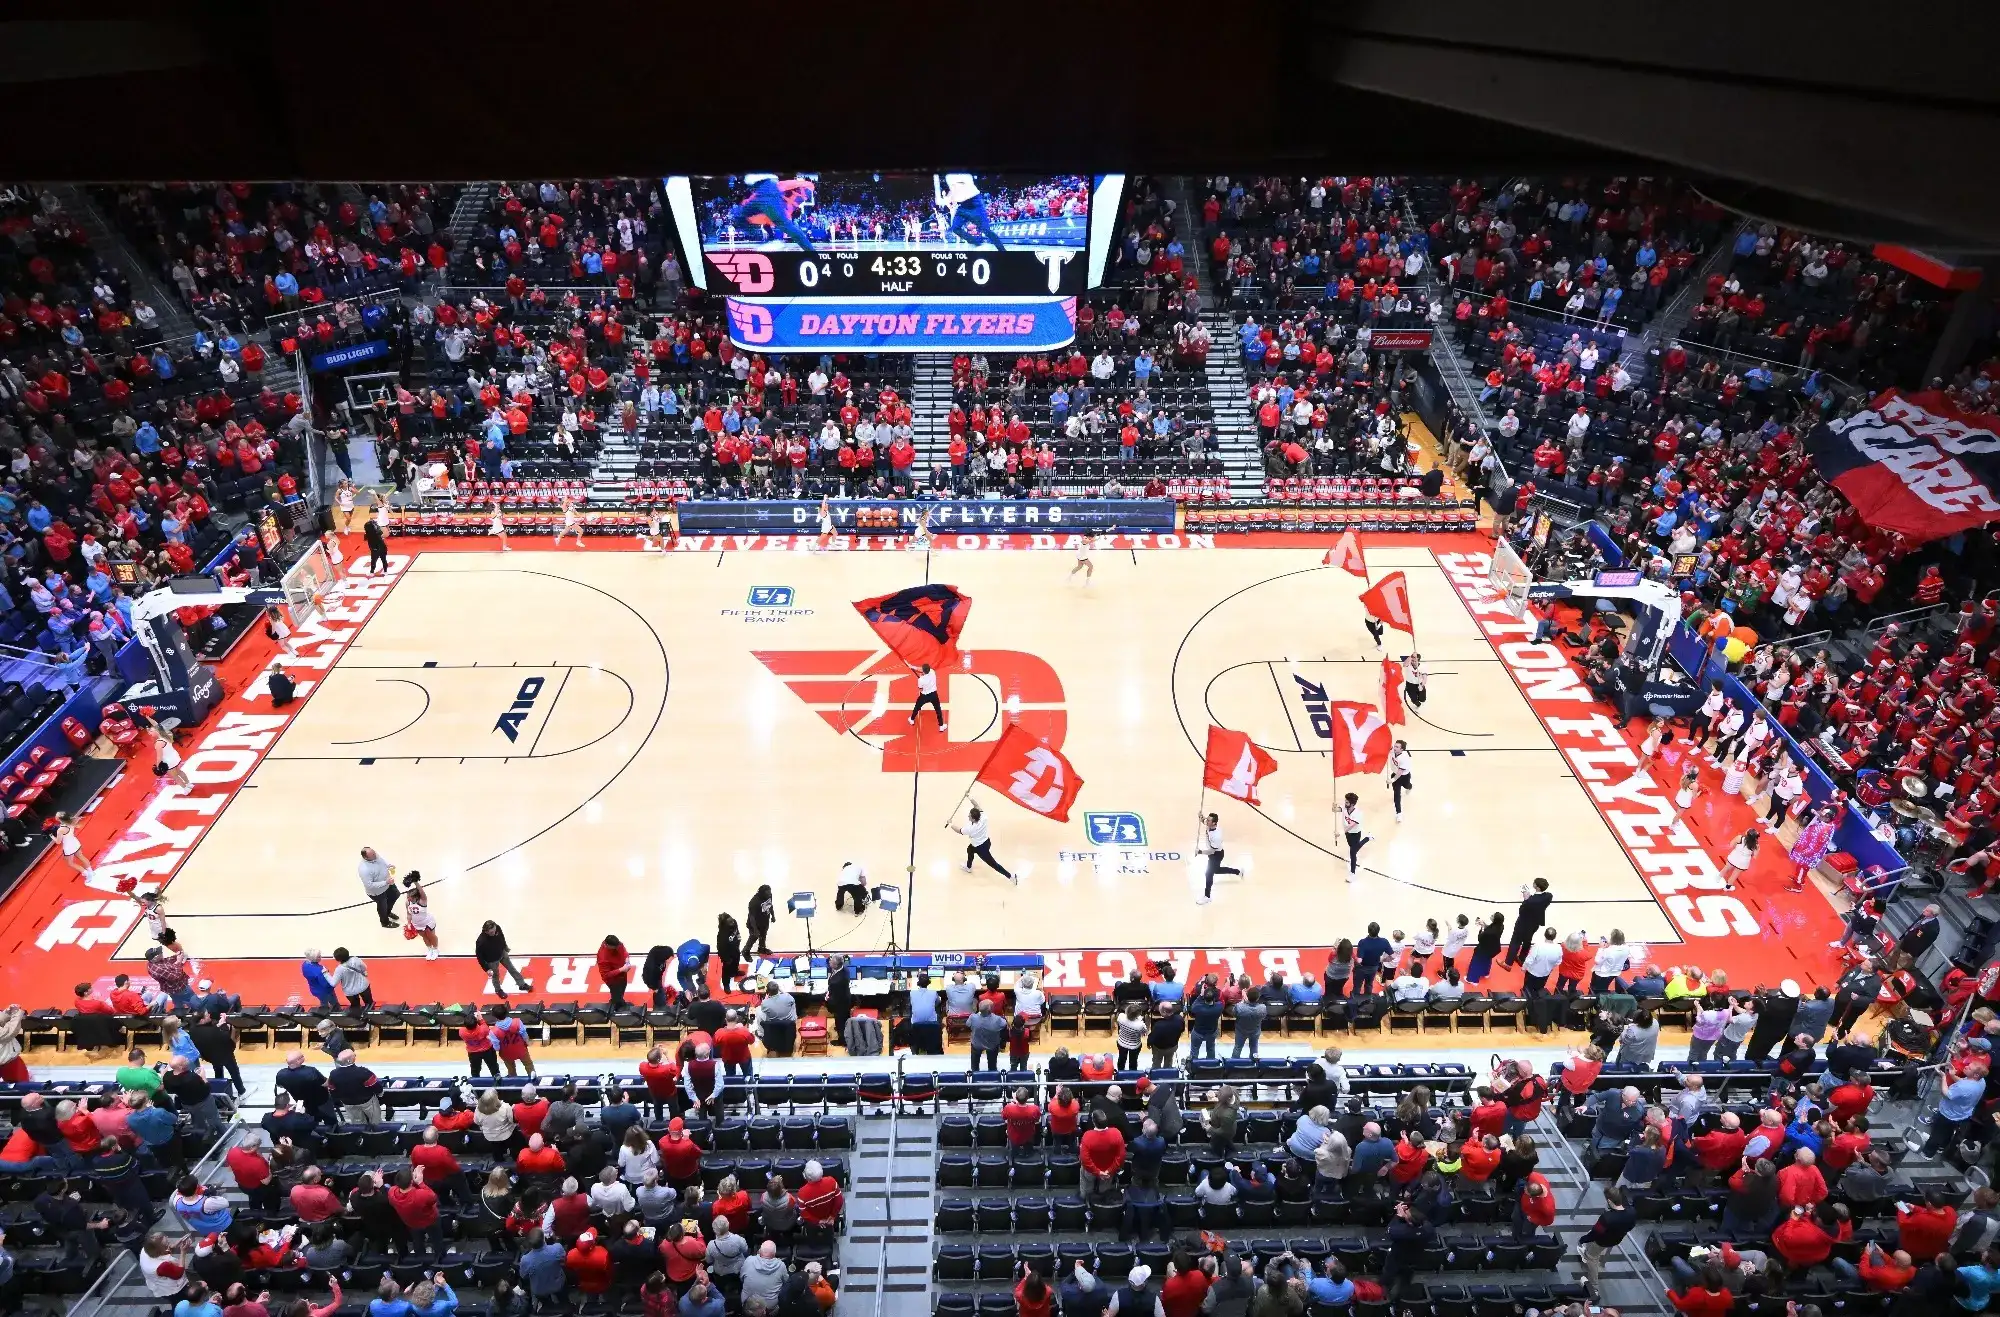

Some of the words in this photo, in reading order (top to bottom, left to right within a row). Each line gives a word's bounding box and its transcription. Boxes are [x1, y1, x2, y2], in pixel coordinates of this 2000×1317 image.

[800, 261, 818, 287] 0
[822, 264, 832, 277] 4
[843, 263, 853, 277] 0
[870, 257, 921, 276] 4:33
[937, 263, 947, 277] 0
[957, 263, 967, 277] 4
[972, 259, 990, 285] 0
[881, 282, 913, 292] HALF
[800, 314, 920, 335] DAYTON
[923, 314, 1035, 335] FLYERS
[1372, 335, 1424, 346] Budweiser
[326, 353, 347, 364] BUD
[347, 346, 375, 359] LIGHT
[1827, 410, 2000, 514] SCARE
[940, 506, 1062, 523] FLYERS
[956, 535, 1010, 549] OF
[1677, 563, 1690, 572] 30
[119, 572, 133, 581] 30
[192, 678, 213, 703] Kroger
[491, 676, 545, 744] A10
[1293, 673, 1333, 739] A10
[34, 711, 291, 951] DAYTON
[1545, 712, 1761, 937] FLYERS
[934, 953, 963, 963] WHIO
